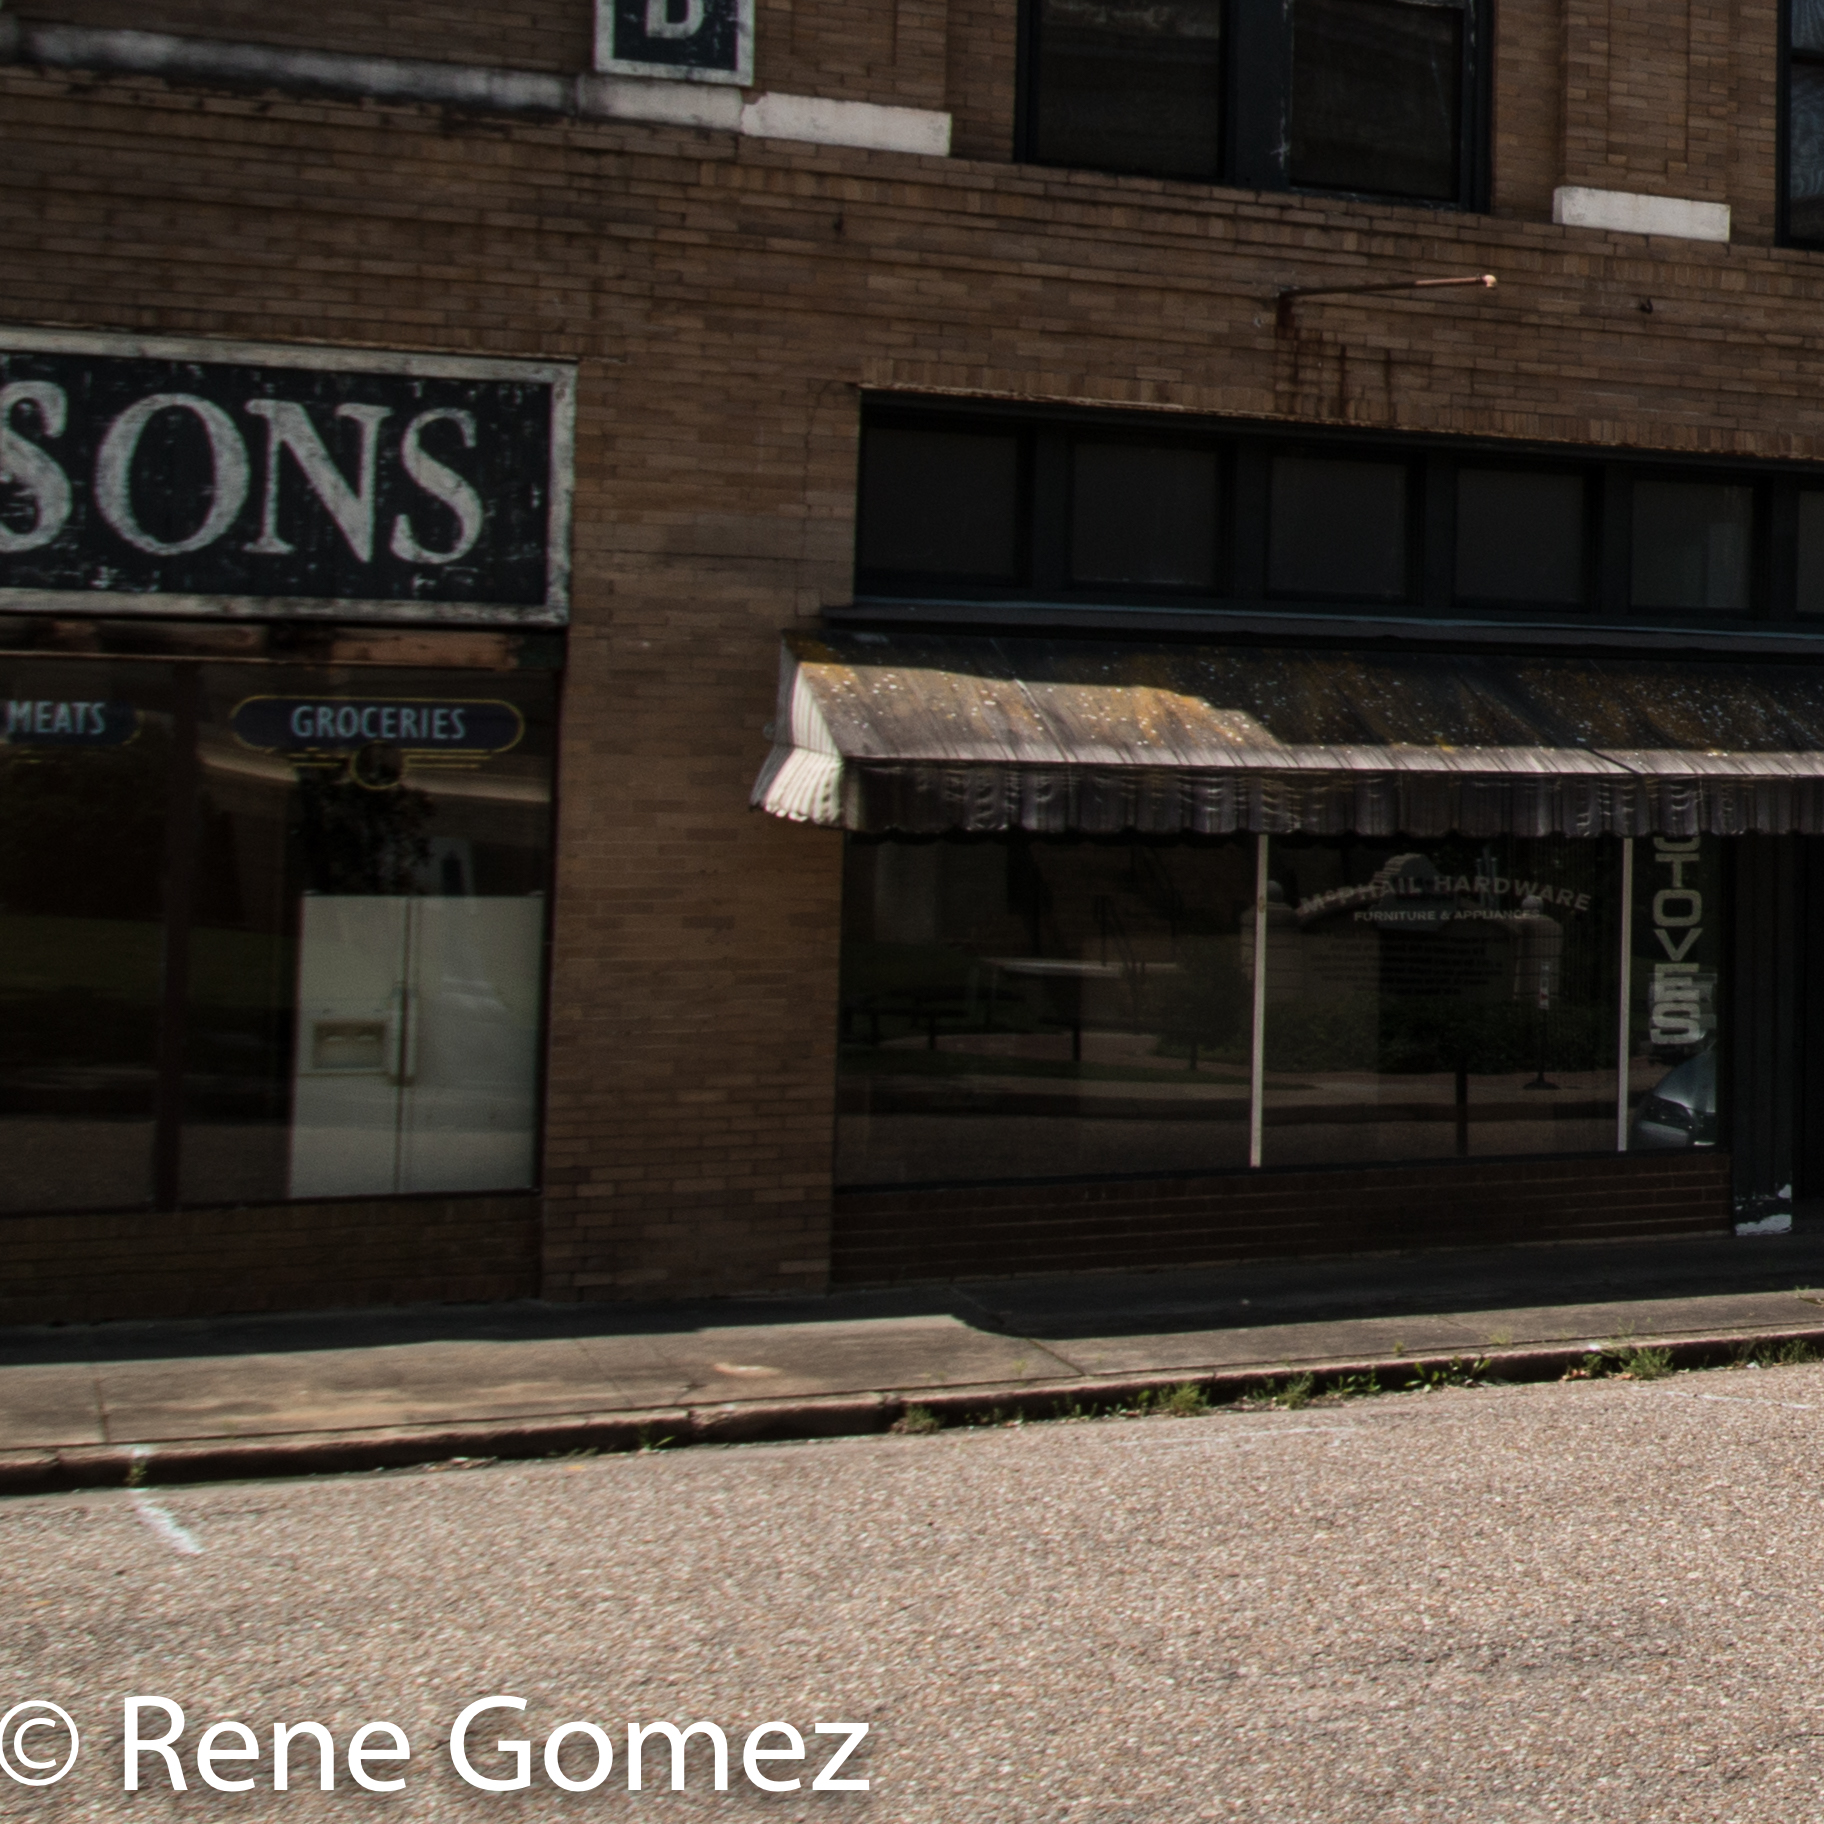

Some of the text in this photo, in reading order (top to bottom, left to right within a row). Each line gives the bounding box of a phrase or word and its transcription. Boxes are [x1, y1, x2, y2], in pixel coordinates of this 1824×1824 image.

[0, 380, 483, 564] SONS
[7, 701, 106, 736] MEATS
[290, 705, 467, 740] GROCERIES
[1434, 875, 1592, 912] HARDWARE
[1353, 909, 1540, 922] FURNITURE & APPLIANCES
